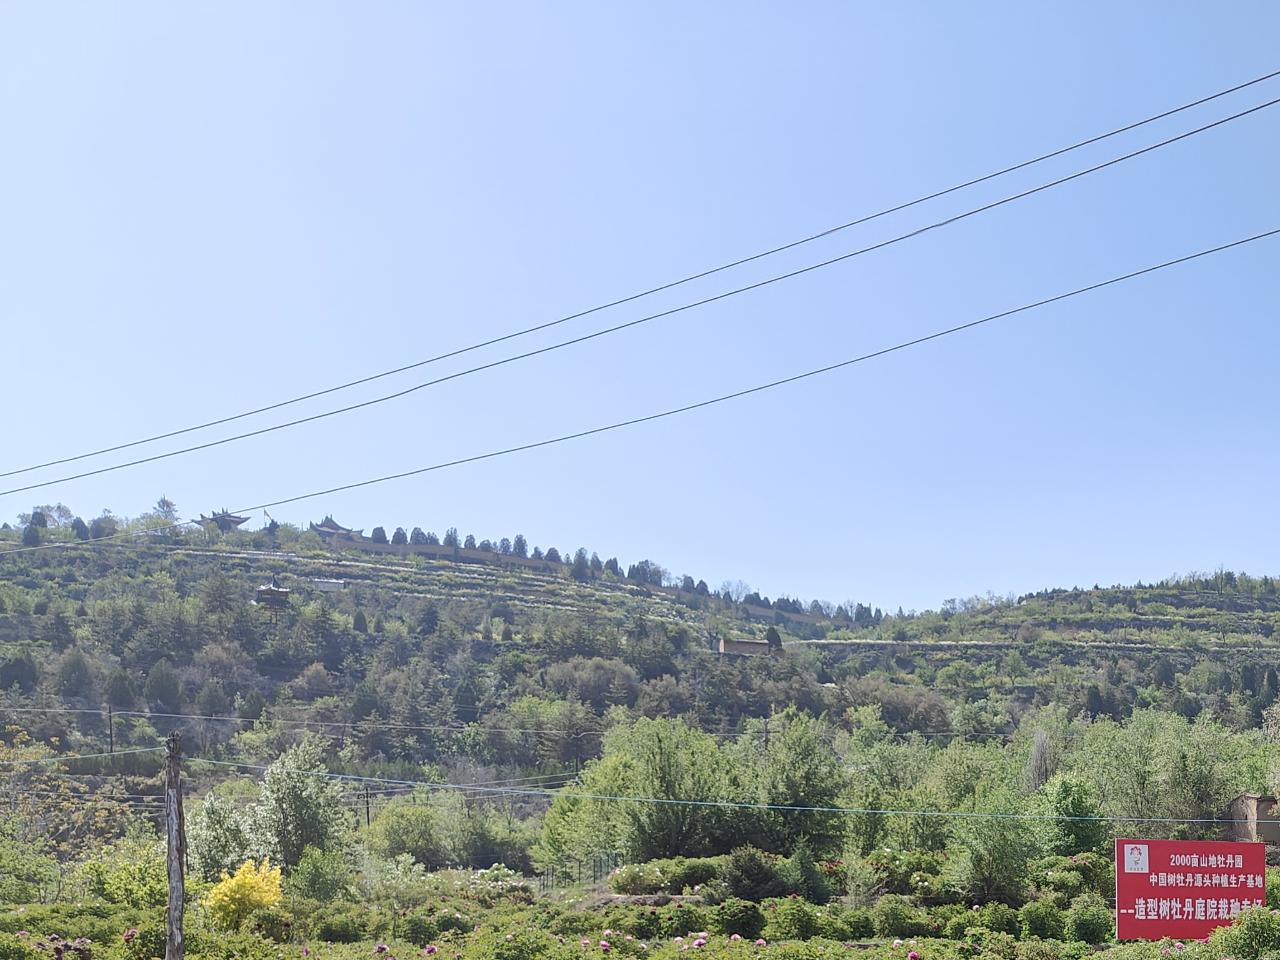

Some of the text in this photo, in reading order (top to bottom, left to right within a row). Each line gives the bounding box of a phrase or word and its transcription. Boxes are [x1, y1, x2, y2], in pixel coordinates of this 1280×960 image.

[1170, 854, 1243, 868] 2000亩山地牡丹园
[1150, 872, 1263, 888] 中国树牡丹源头种植生产基地
